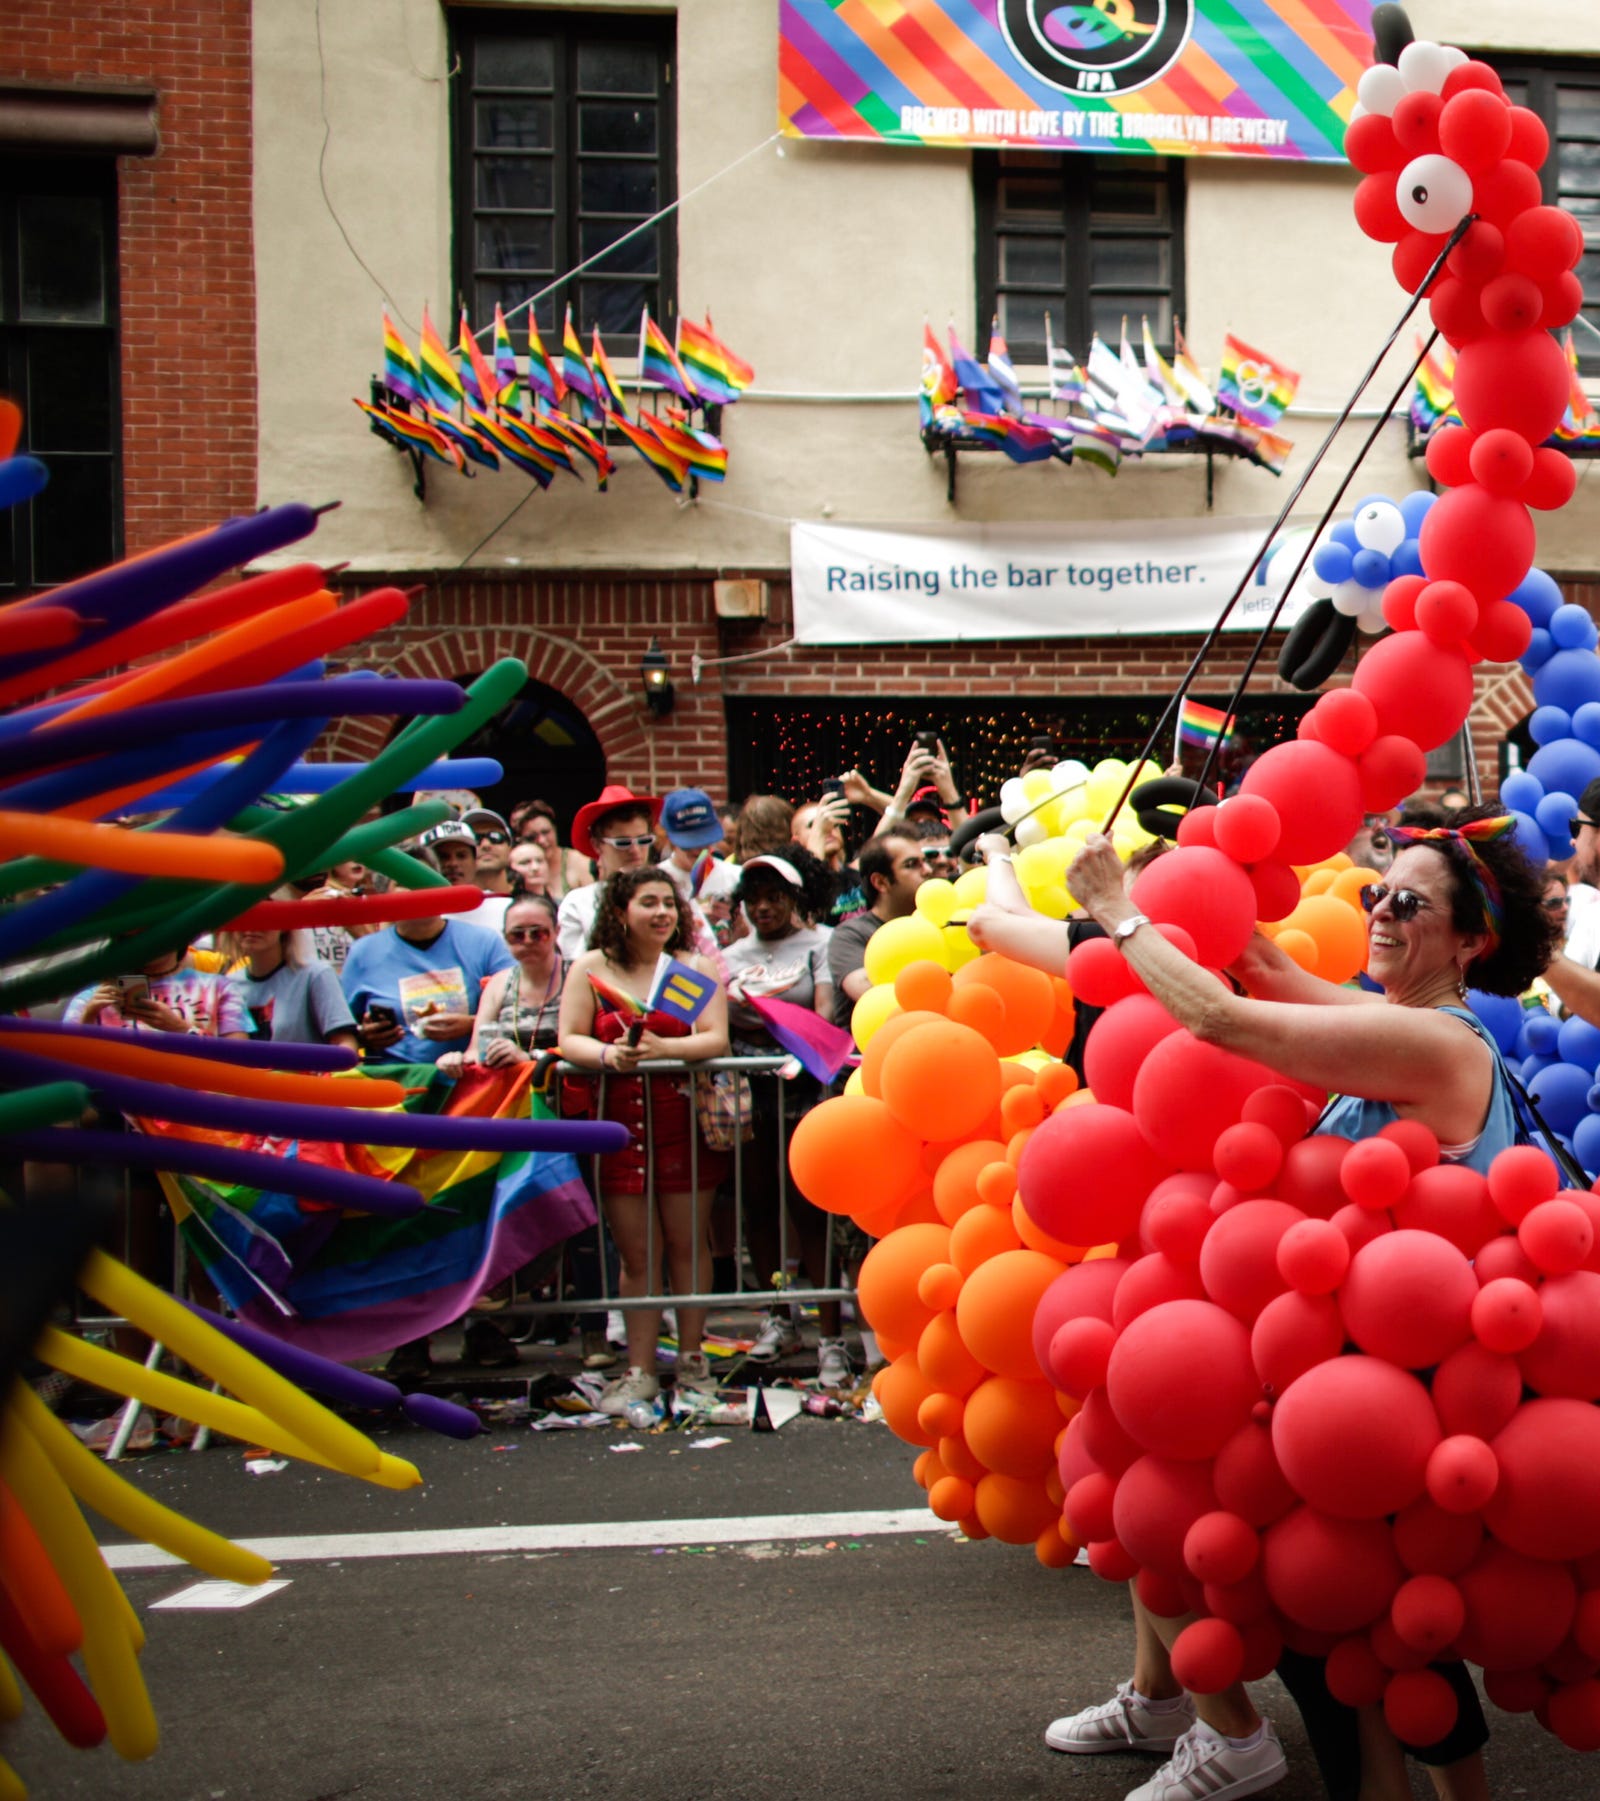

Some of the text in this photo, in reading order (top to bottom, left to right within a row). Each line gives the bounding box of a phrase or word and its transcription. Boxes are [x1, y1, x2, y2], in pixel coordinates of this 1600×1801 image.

[1076, 70, 1118, 92] IPA
[900, 105, 1289, 146] BREWED WITH LOVE BY THE BROOKLYN BREWERY
[826, 560, 1206, 597] Raising the bar together.
